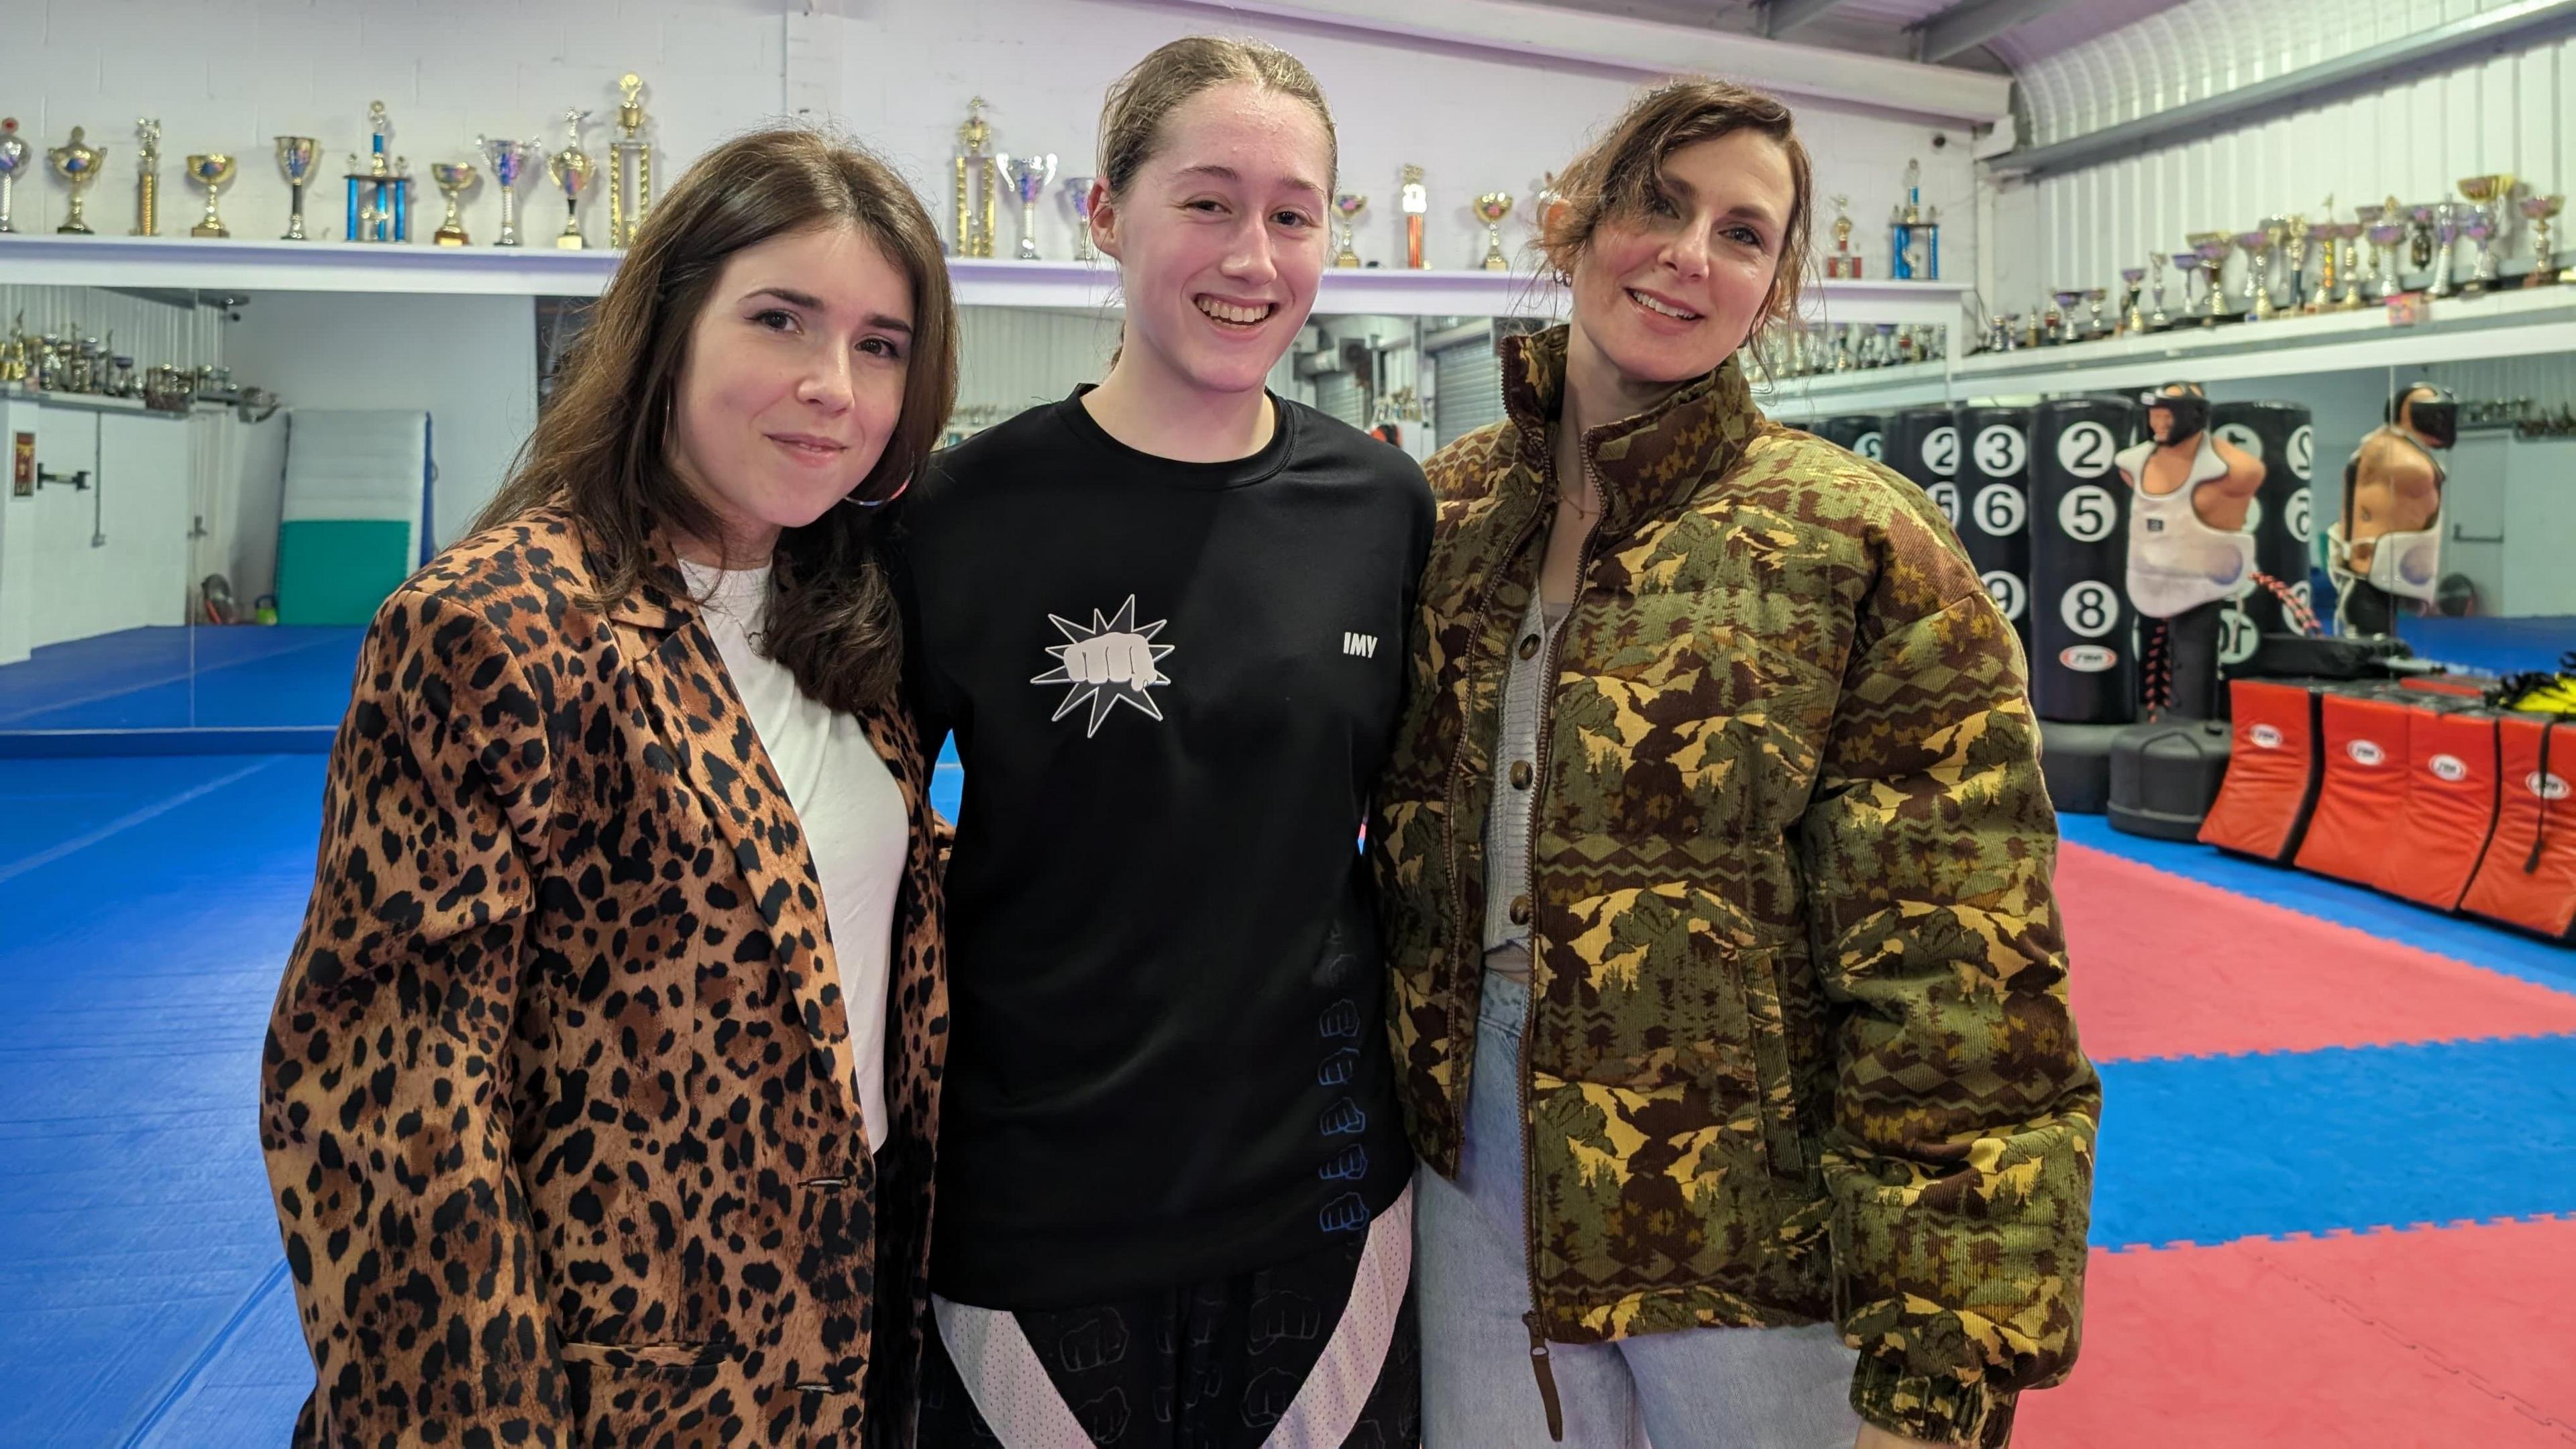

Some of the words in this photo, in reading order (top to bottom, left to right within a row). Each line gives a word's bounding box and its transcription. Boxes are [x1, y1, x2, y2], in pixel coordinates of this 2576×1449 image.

[1935, 433, 1953, 467] 2
[1984, 431, 2013, 470] 3
[2072, 427, 2103, 469] 2
[1986, 490, 2013, 529] 6
[2073, 494, 2104, 536] 5
[1986, 578, 2013, 614] 9
[2076, 588, 2106, 629] 8
[1343, 631, 1379, 659] IMY
